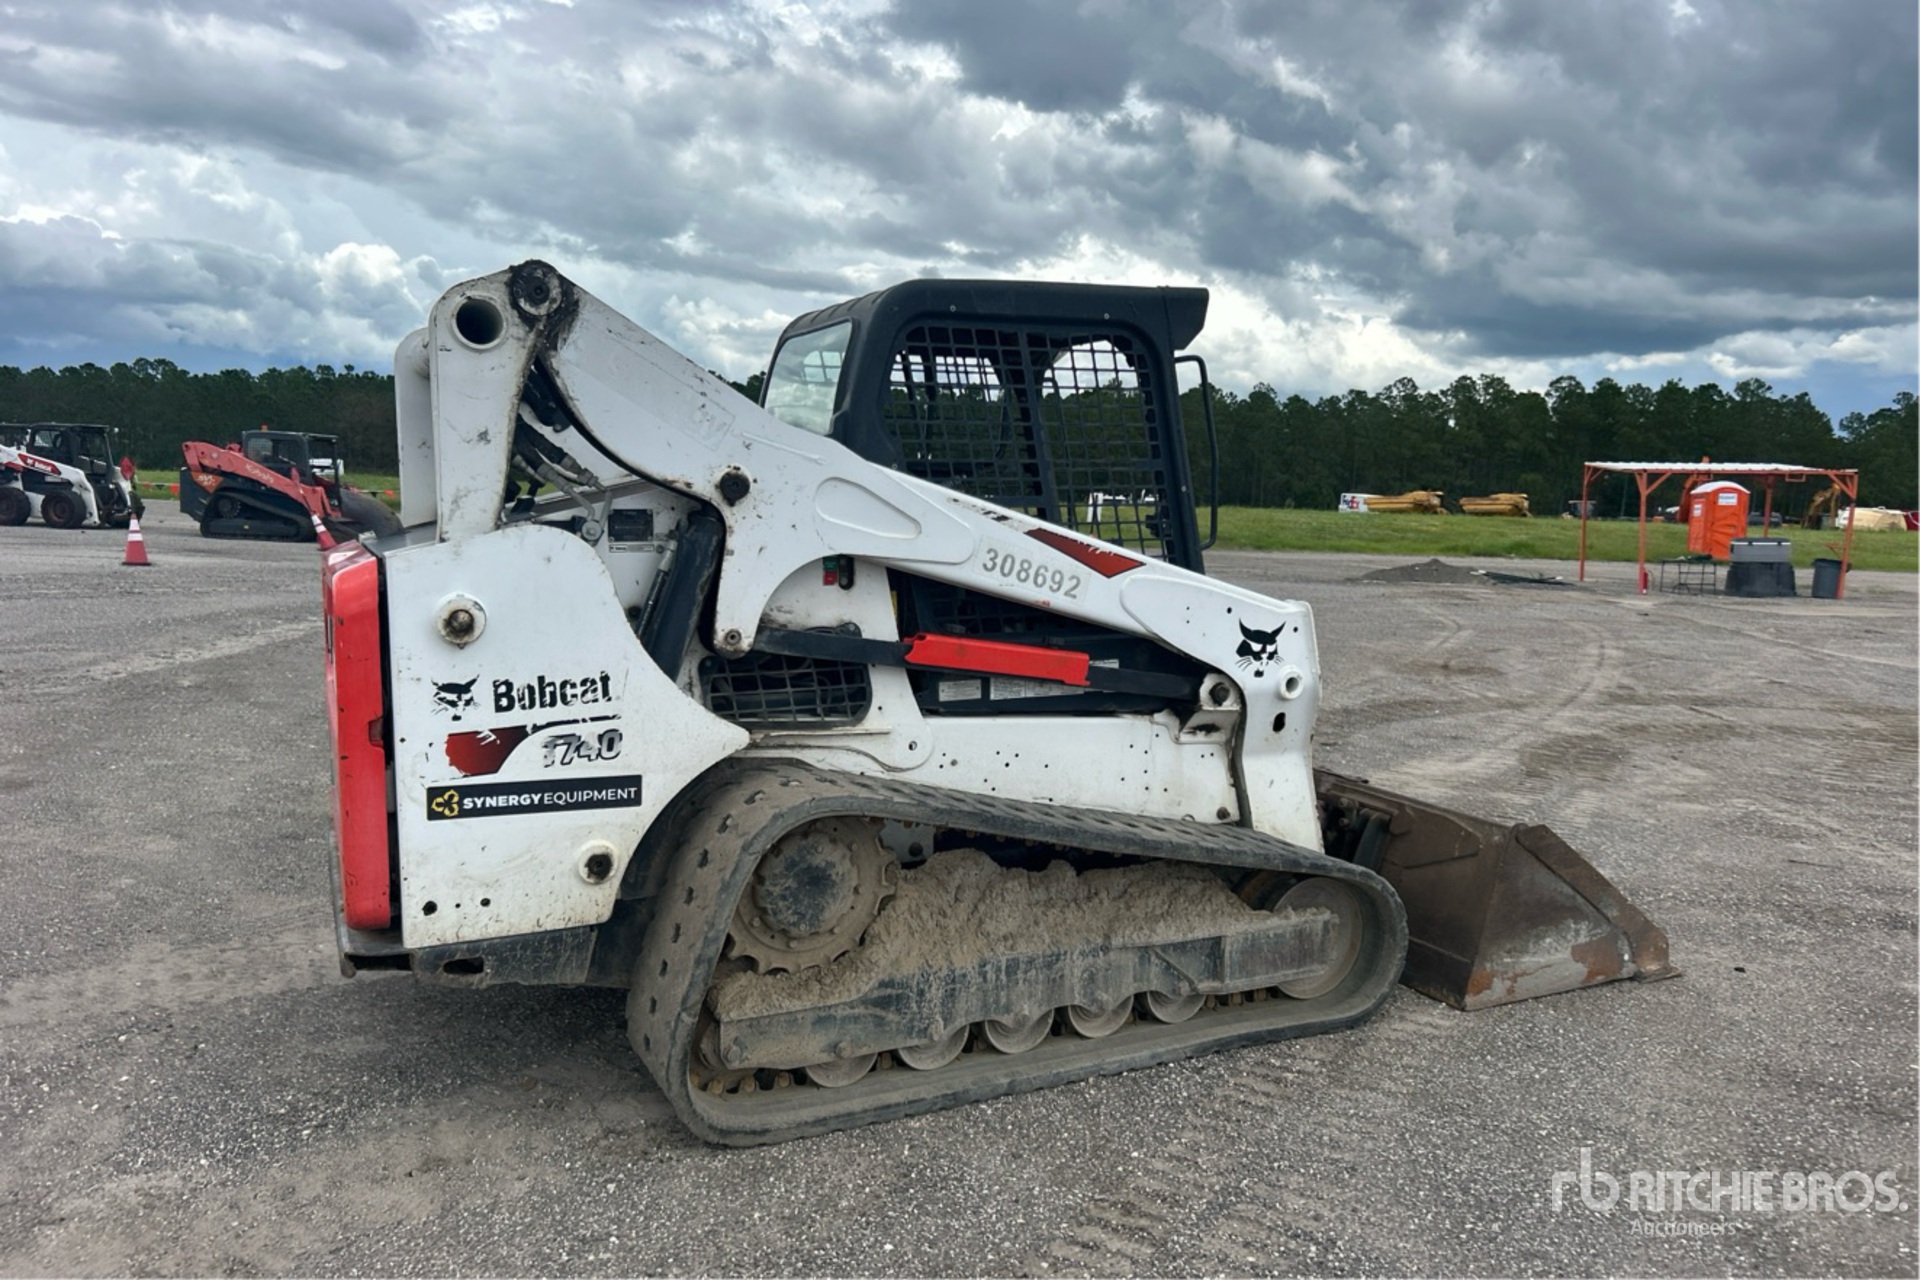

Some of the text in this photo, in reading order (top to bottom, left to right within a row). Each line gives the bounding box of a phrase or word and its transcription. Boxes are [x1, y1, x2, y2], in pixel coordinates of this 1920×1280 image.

[982, 548, 1081, 599] 308692
[493, 672, 612, 713] Bobcat
[542, 728, 623, 768] T740
[463, 788, 638, 809] SYNERGY EQUIPMENT
